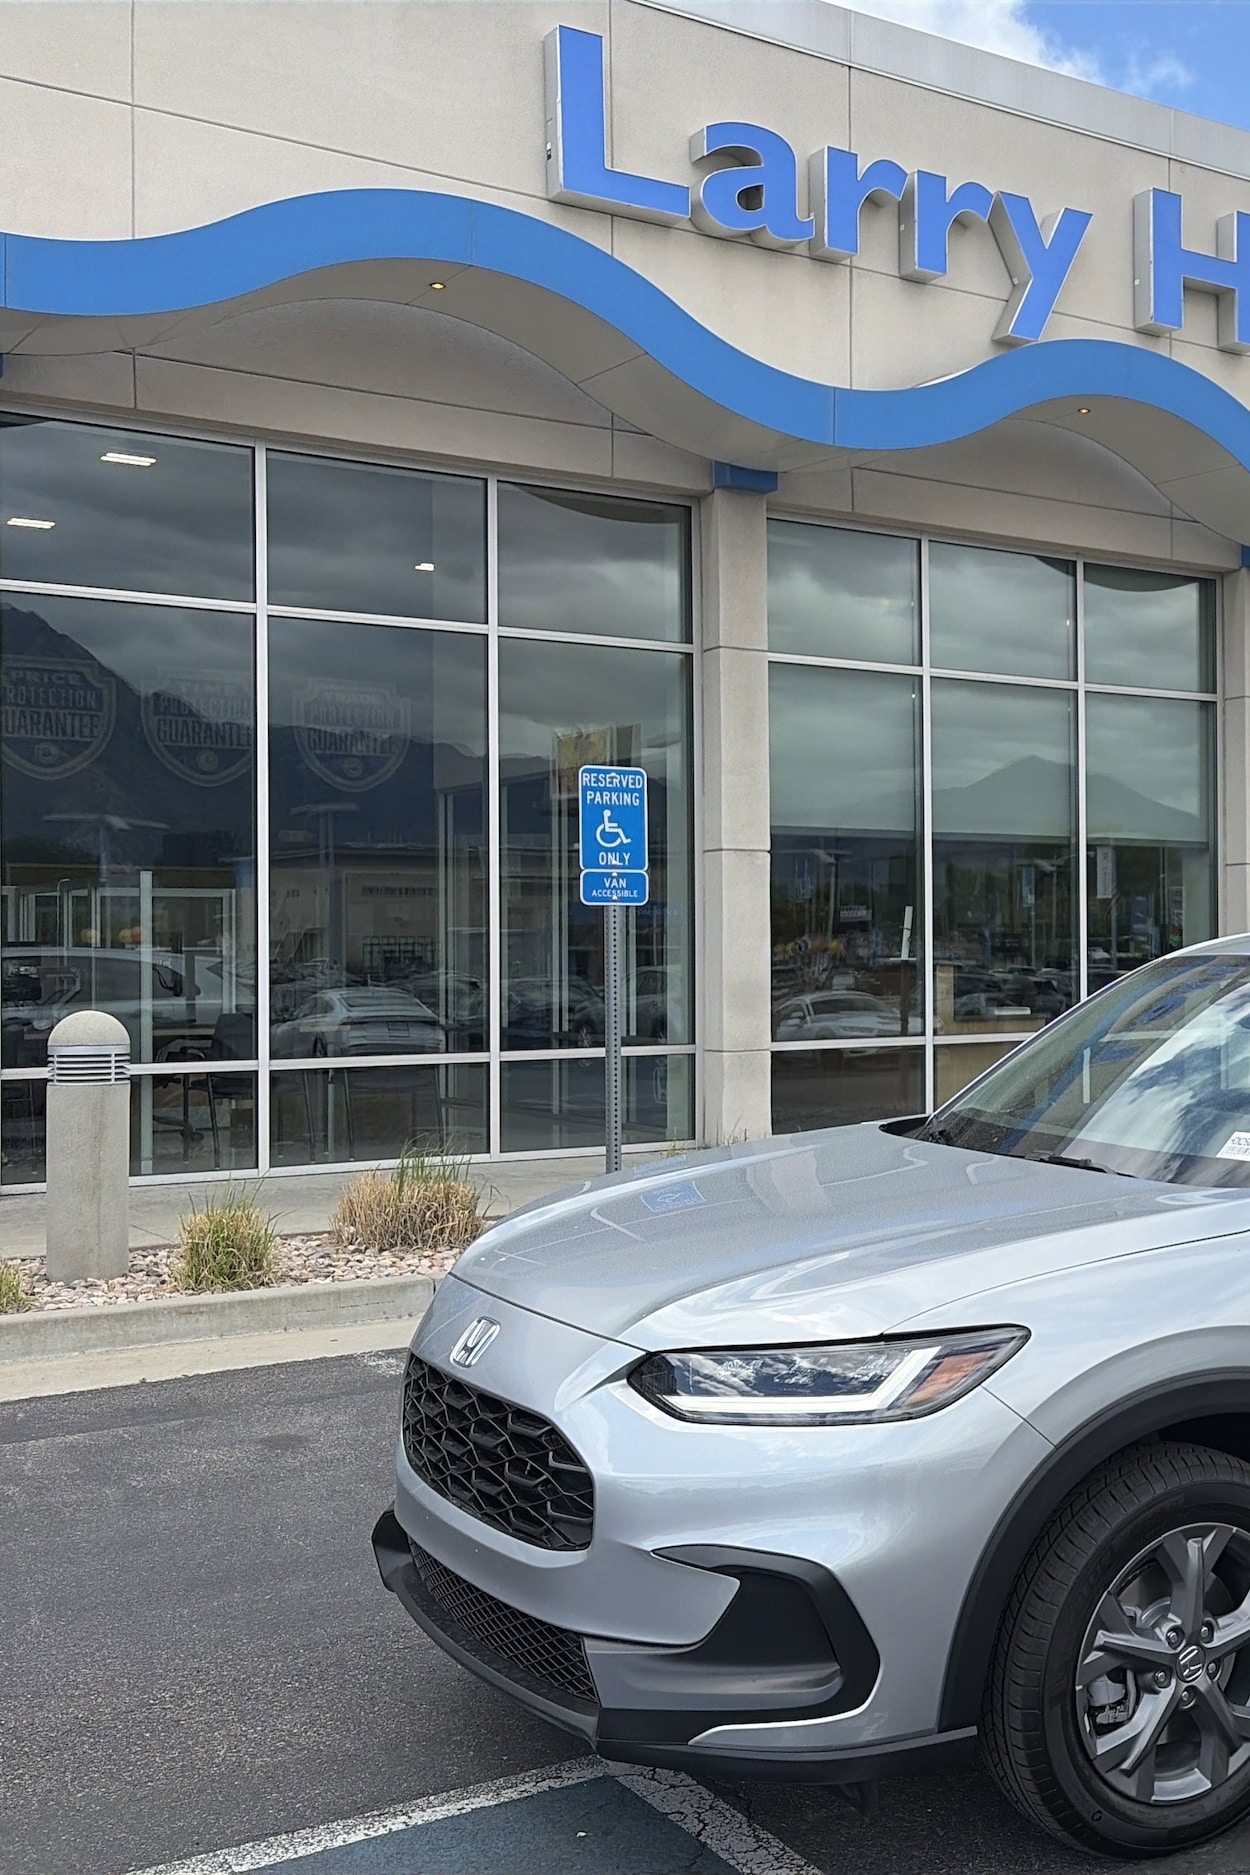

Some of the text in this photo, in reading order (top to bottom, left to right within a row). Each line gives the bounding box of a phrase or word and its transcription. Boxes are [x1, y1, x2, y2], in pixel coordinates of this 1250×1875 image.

[546, 24, 1094, 346] Larry
[11, 671, 83, 686] PRICE
[3, 685, 96, 709] ROTECTION
[3, 709, 99, 739] UARANTEE
[583, 772, 643, 789] RESERVED
[586, 791, 640, 806] PARKING
[598, 852, 631, 866] ONLY
[604, 877, 627, 888] VAN
[591, 889, 638, 898] ACCESSIBLE
